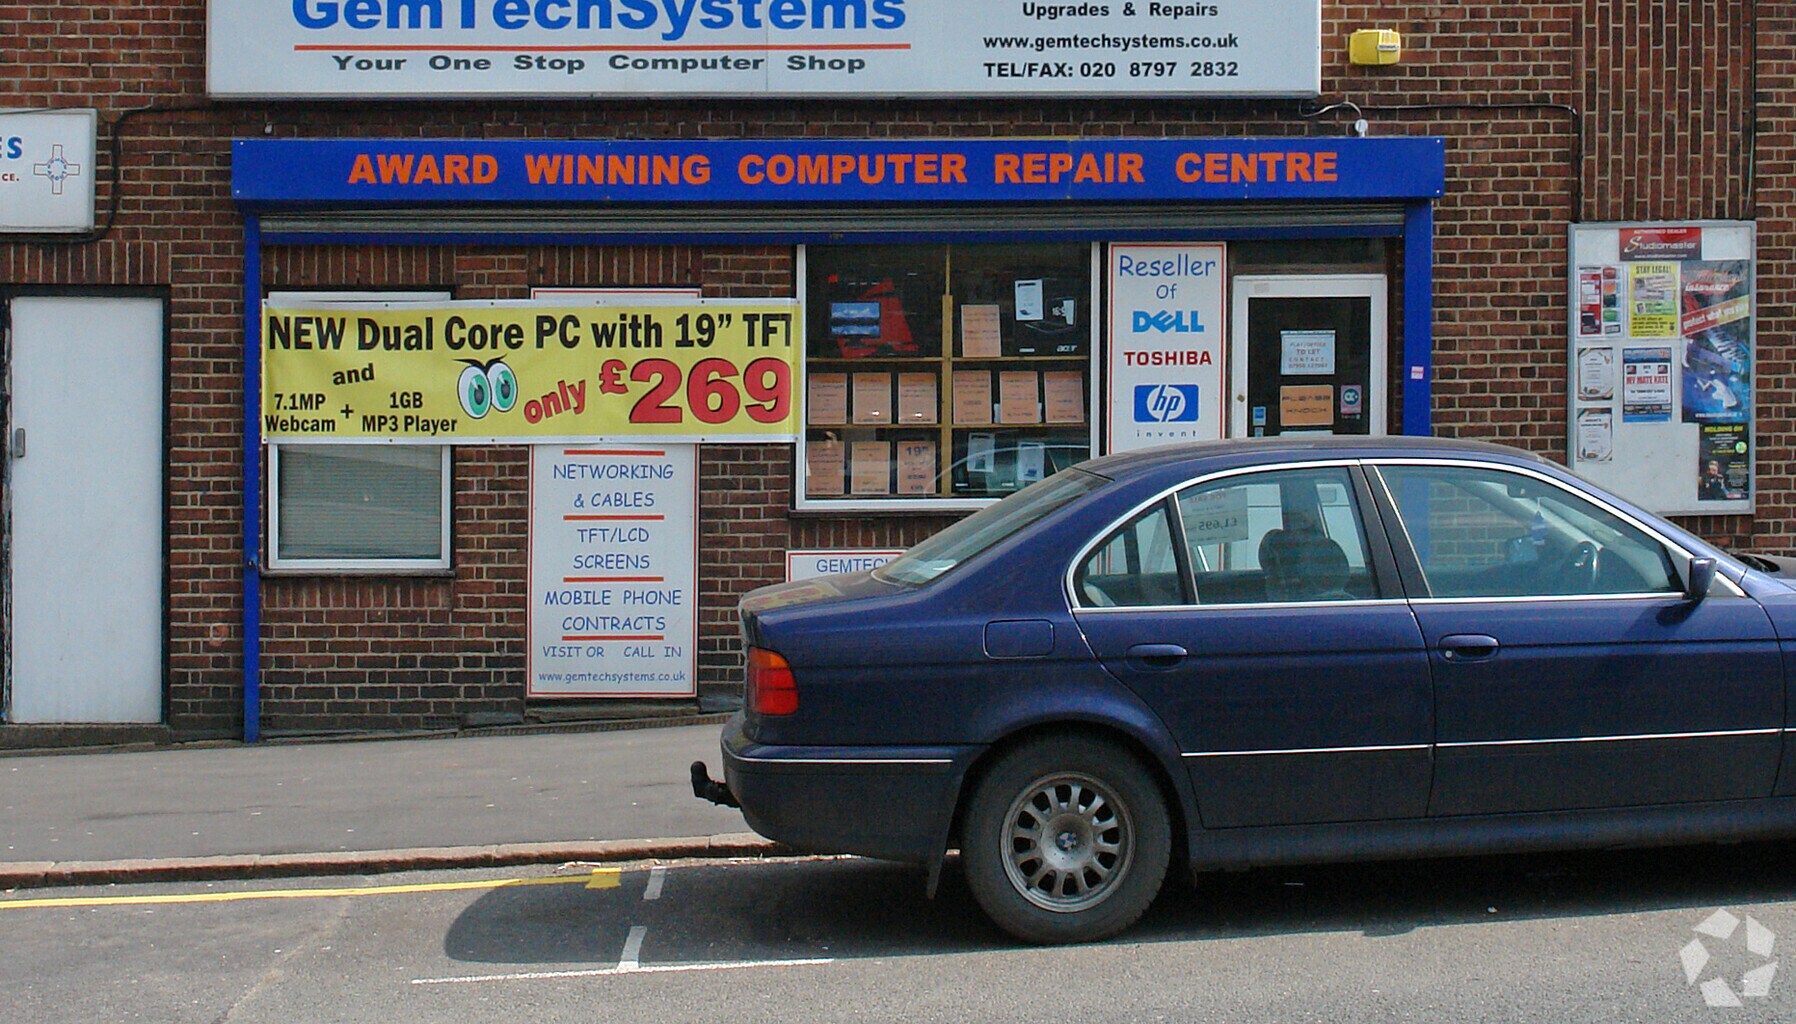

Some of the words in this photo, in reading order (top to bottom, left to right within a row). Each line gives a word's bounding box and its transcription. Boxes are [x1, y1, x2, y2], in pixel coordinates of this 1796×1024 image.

[1022, 1, 1110, 20] Upgrades
[1122, 2, 1136, 17] &
[1149, 1, 1219, 20] Repairs
[983, 33, 1239, 52] www.gemtechsystems.co.uk
[333, 55, 407, 71] Your
[428, 54, 492, 71] One
[513, 54, 586, 74] Stop
[608, 53, 765, 74] Computer
[786, 54, 867, 74] Shop
[983, 62, 1074, 78] TEL/FAX:
[1079, 62, 1116, 78] 020
[1129, 61, 1177, 77] 8797
[1190, 61, 1239, 77] 2832
[0, 136, 23, 160] S
[348, 153, 499, 185] AWARD
[524, 153, 711, 185] WINNING
[737, 153, 968, 185] COMPUTER
[994, 153, 1146, 184] REPAIR
[1175, 152, 1339, 183] CENTRE
[1623, 236, 1697, 253] Studiomaster
[1119, 253, 1216, 277] Reseller
[1635, 265, 1651, 274] STAY
[1156, 283, 1177, 300] Of
[1132, 310, 1205, 334] DELL
[268, 316, 347, 351] NEW
[357, 316, 434, 351] Dual
[444, 315, 524, 351] Core
[535, 314, 581, 349] PC
[591, 313, 663, 349] with
[743, 313, 792, 347] TFT
[1123, 351, 1212, 366] TOSHIBA
[332, 363, 375, 386] and
[599, 356, 792, 425] £269
[274, 393, 326, 411] 7.1MP
[389, 391, 424, 409] 1GB
[523, 379, 587, 424] only
[1153, 385, 1181, 422] hp
[265, 414, 336, 433] Webcam
[361, 415, 398, 432] MP3
[403, 414, 458, 435] Player
[1136, 430, 1196, 438] invent
[553, 463, 674, 480] NETWORKING
[573, 493, 585, 508] &
[590, 492, 655, 509] CABLES
[576, 527, 650, 543] TFT/LCD
[573, 553, 650, 570] SCREENS
[816, 558, 889, 573] GEMTEC
[544, 589, 611, 606] MOBILE
[622, 589, 682, 606] PHONE
[562, 616, 666, 633] CONTRACTS
[542, 646, 583, 658] VISIT
[585, 646, 605, 658] OR
[623, 646, 655, 658] CALL
[664, 646, 682, 658] IN
[538, 671, 686, 685] www.gemtechsystems.co.uk
